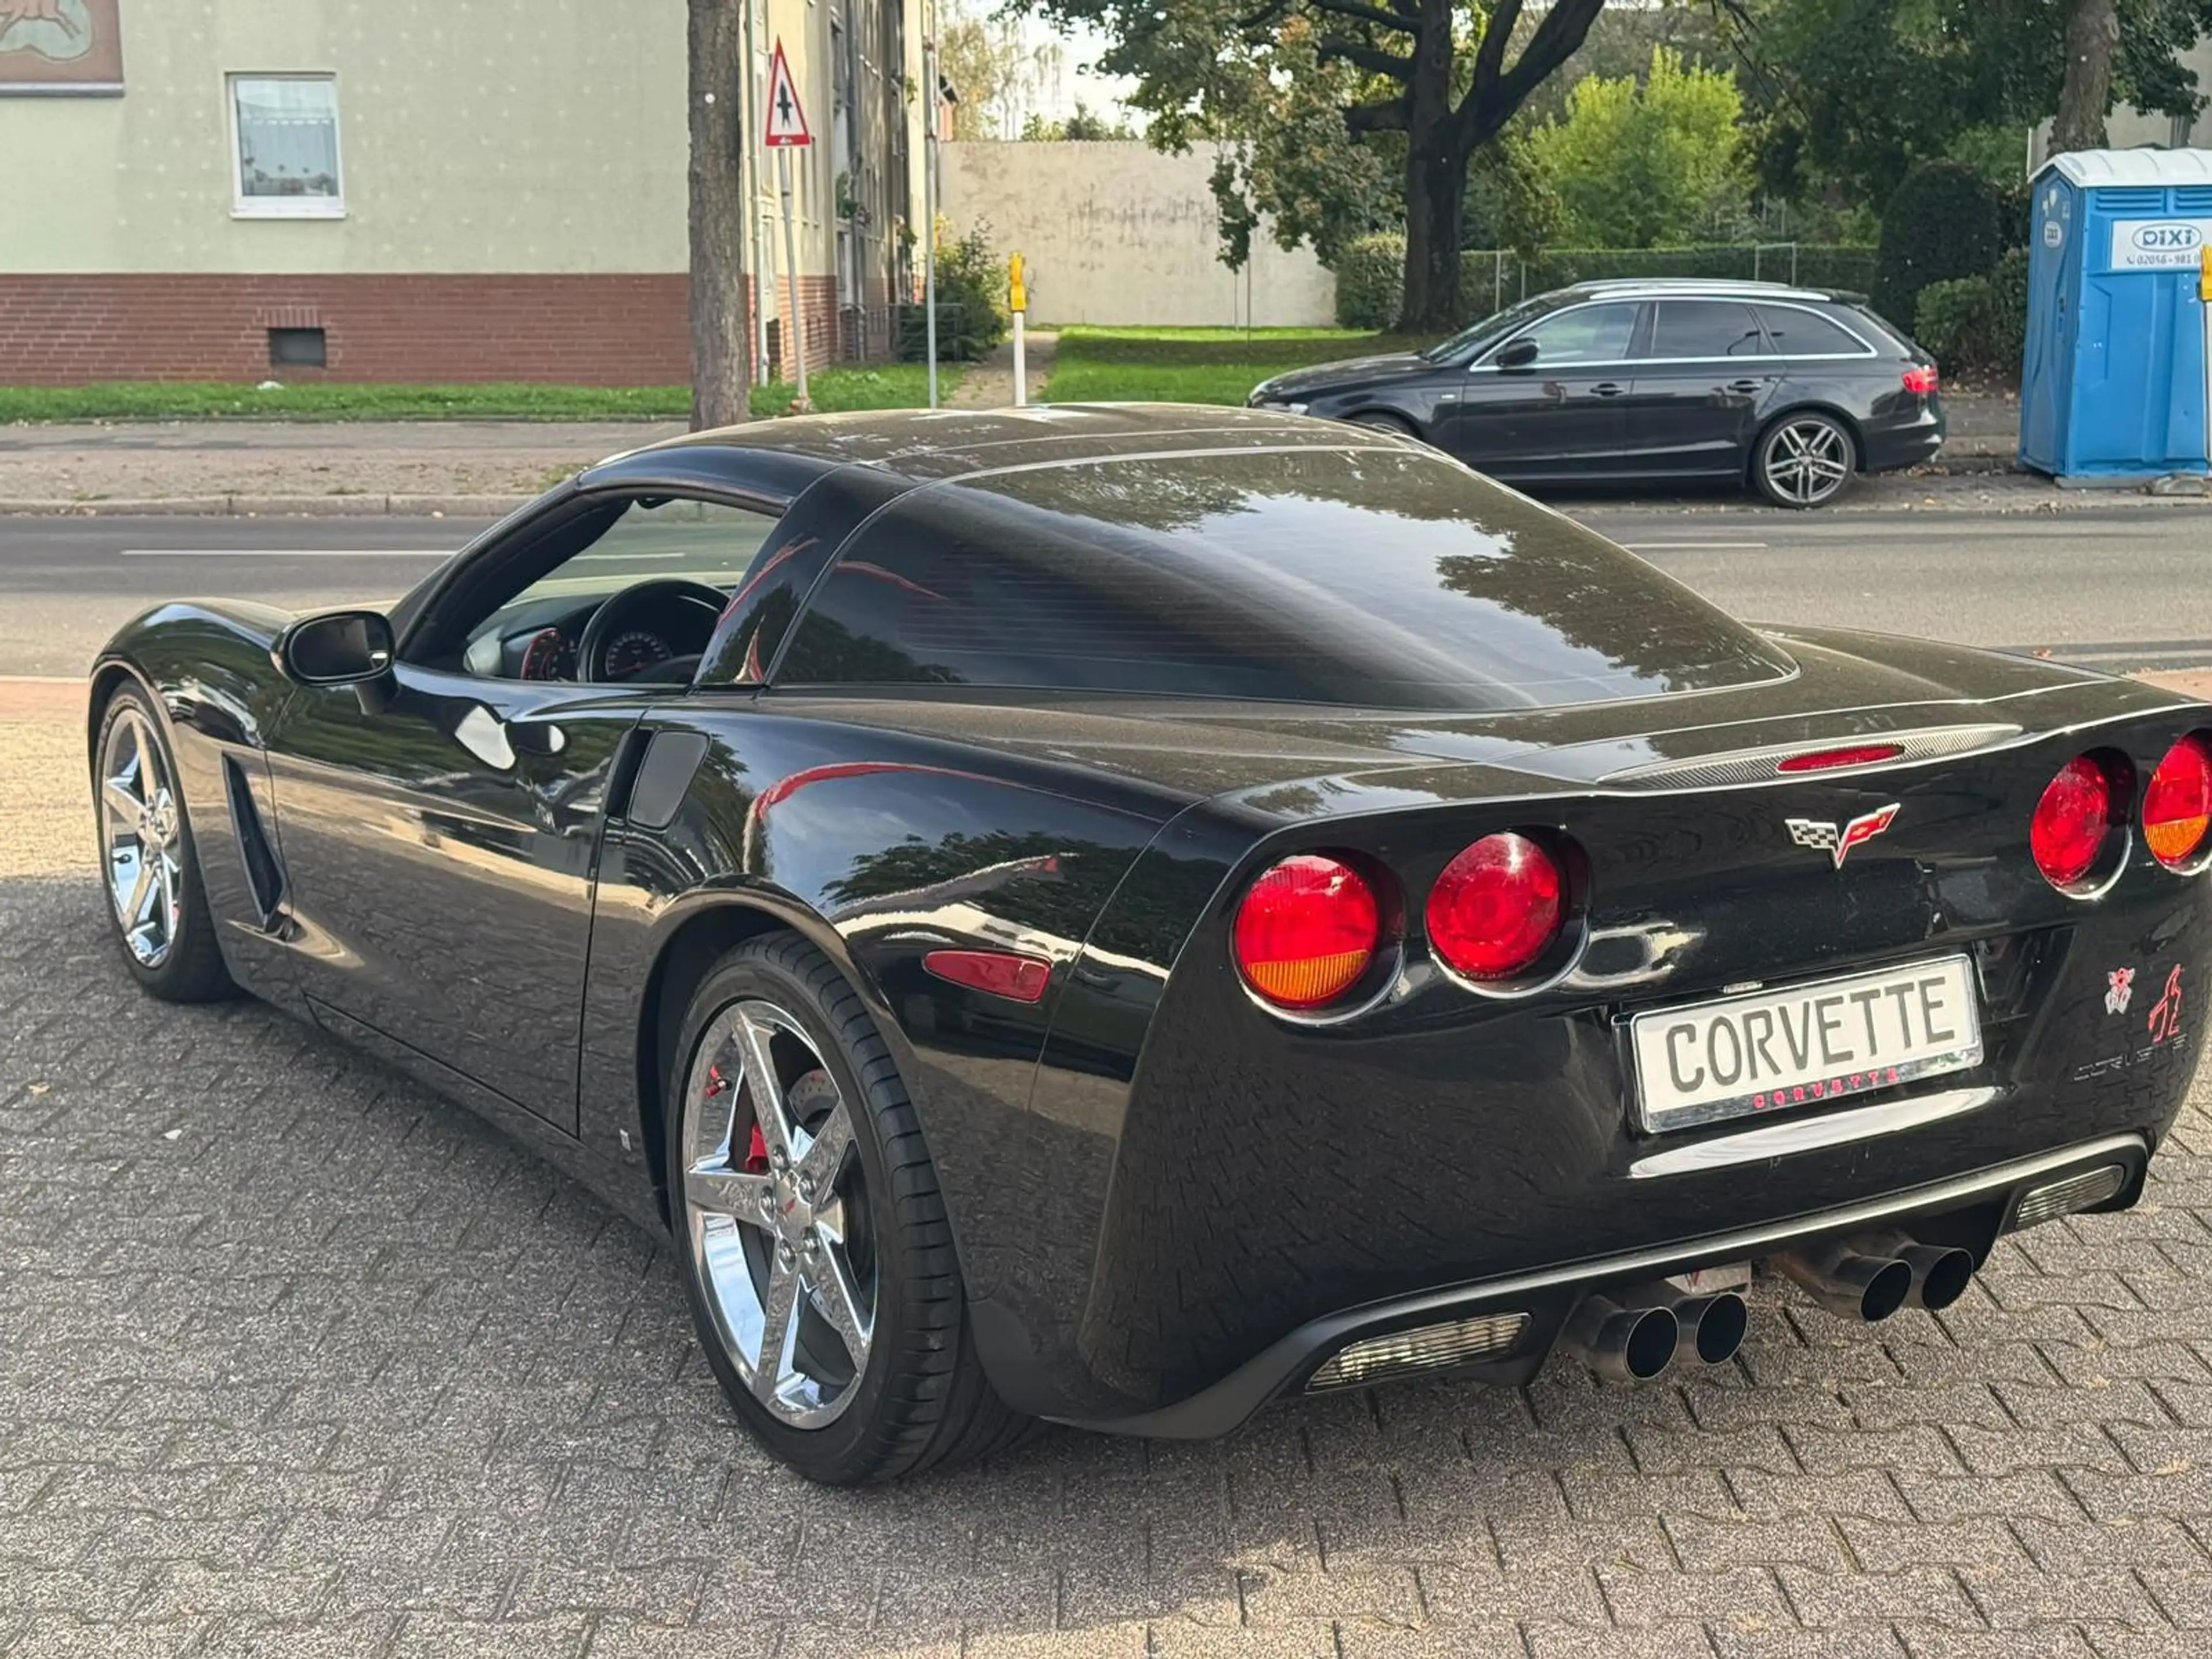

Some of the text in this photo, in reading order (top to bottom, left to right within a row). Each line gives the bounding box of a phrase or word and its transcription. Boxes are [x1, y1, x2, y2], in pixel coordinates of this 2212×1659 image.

[2143, 230, 2192, 245] DIXI
[1666, 976, 1955, 1092] CORVETTE
[1752, 1067, 1898, 1108] CORVETTE
